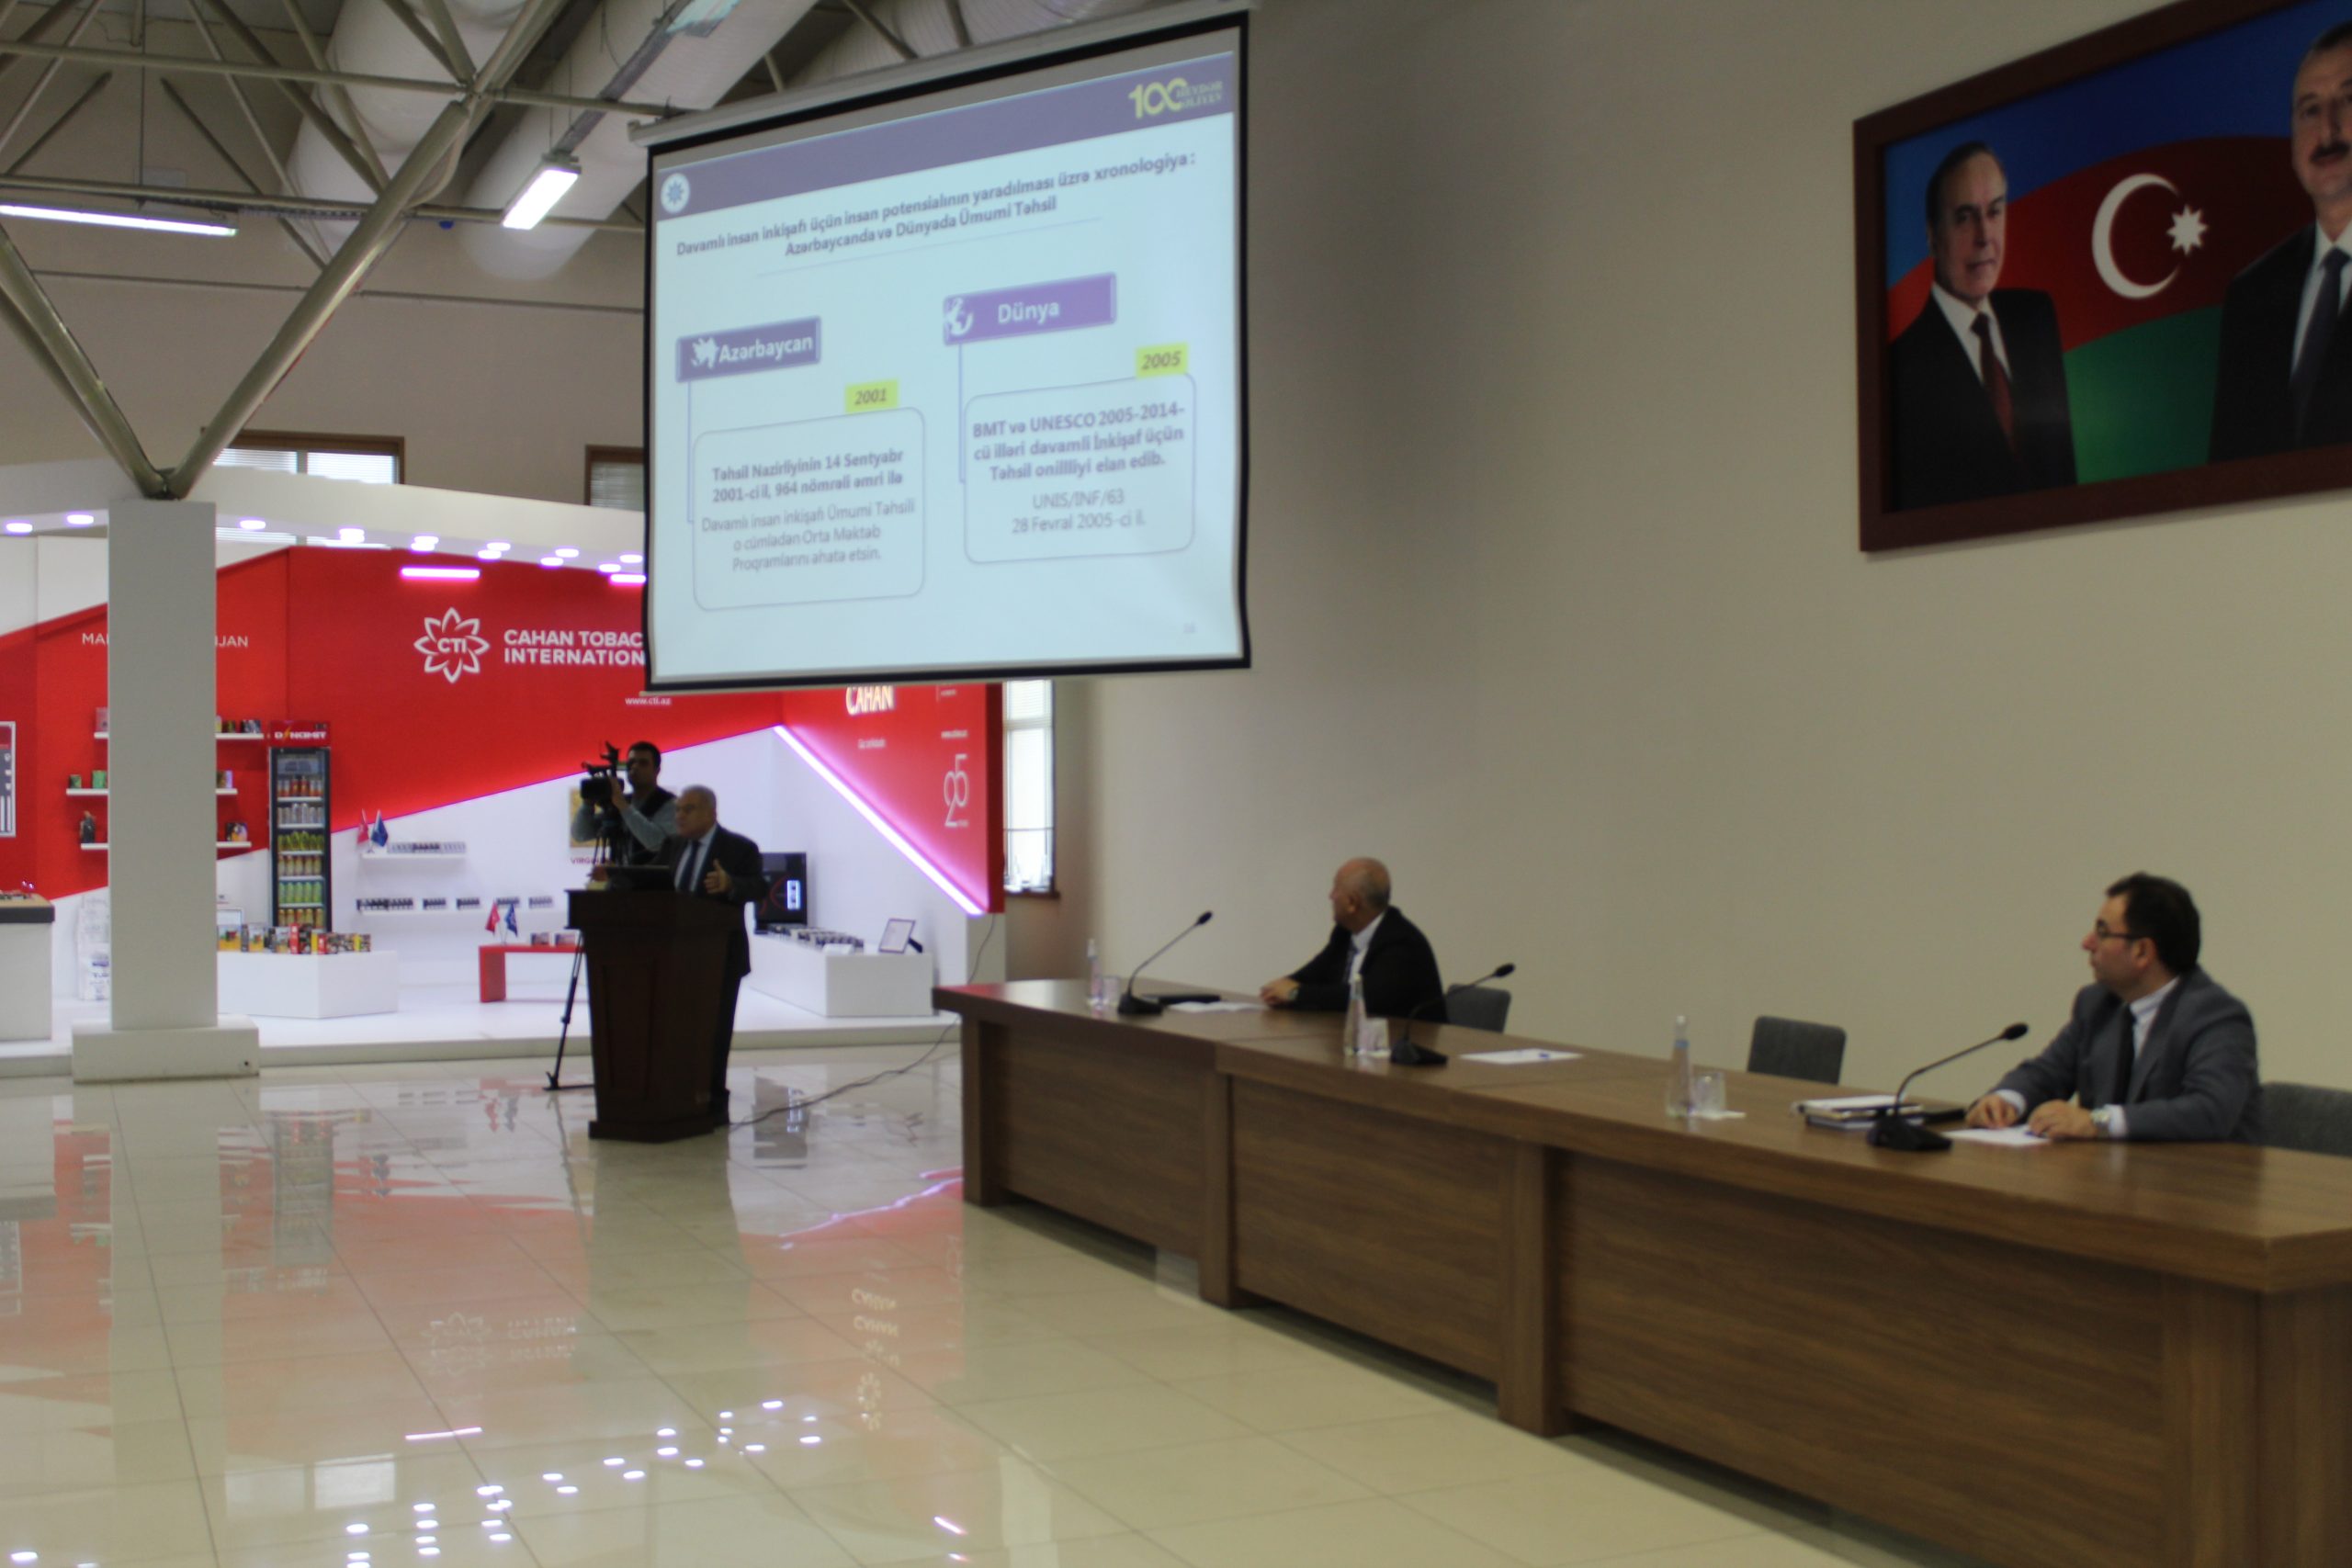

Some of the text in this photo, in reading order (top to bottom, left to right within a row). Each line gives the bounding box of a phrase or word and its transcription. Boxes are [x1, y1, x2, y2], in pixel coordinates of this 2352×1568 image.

[727, 228, 759, 246] insan
[809, 214, 842, 233] üçün
[844, 209, 879, 226] insan
[882, 192, 970, 222] potensialının
[1057, 171, 1091, 187] üzrə
[785, 195, 1057, 257] Azərbaycanda və Dünyada Ümumi Təhsil
[998, 300, 1060, 325] Dünya
[718, 335, 814, 364] Azərbaycan
[1141, 350, 1182, 370] 2005
[854, 387, 888, 406] 2001
[973, 420, 1007, 438] BMT
[1009, 422, 1026, 434] və
[1029, 412, 1096, 433] UNESCO
[974, 446, 991, 461] cü
[1145, 425, 1184, 446] üçün
[712, 464, 749, 482] Təhsil
[824, 455, 841, 470] 14
[843, 447, 904, 468] Sentyabr
[990, 462, 1032, 481] Təhsil
[1095, 456, 1126, 473] elan
[775, 481, 797, 497] 964
[1012, 517, 1029, 535] 28
[1032, 513, 1073, 532] Fevral
[802, 529, 831, 546] Orta
[82, 632, 108, 646] MA
[436, 637, 468, 654] CTI
[503, 629, 573, 647] CAHAN
[846, 684, 896, 716] CAHAN
